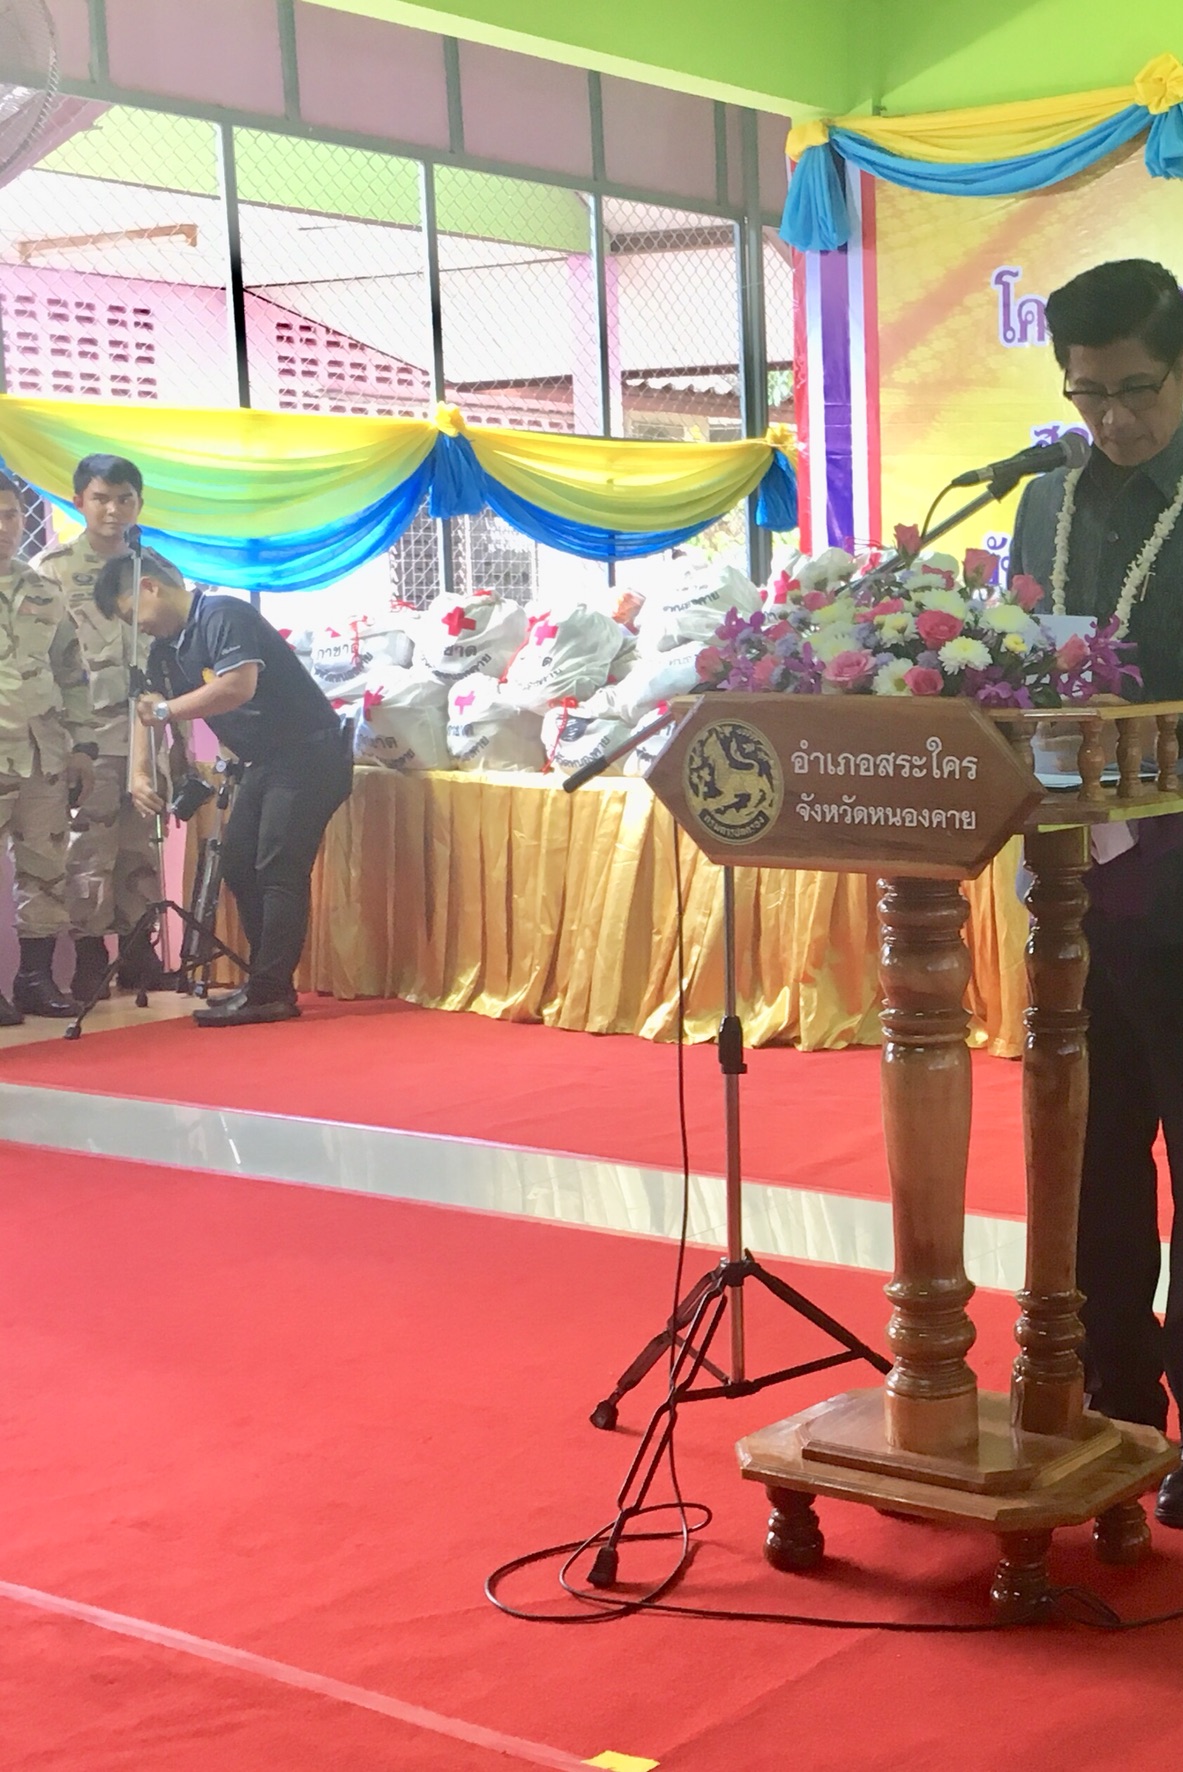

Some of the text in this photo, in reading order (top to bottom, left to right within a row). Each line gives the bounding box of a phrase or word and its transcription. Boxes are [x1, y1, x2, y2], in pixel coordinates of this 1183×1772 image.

[791, 736, 978, 781] อำเภอสระใคร
[795, 792, 976, 831] จังหวัดหนองคาย
